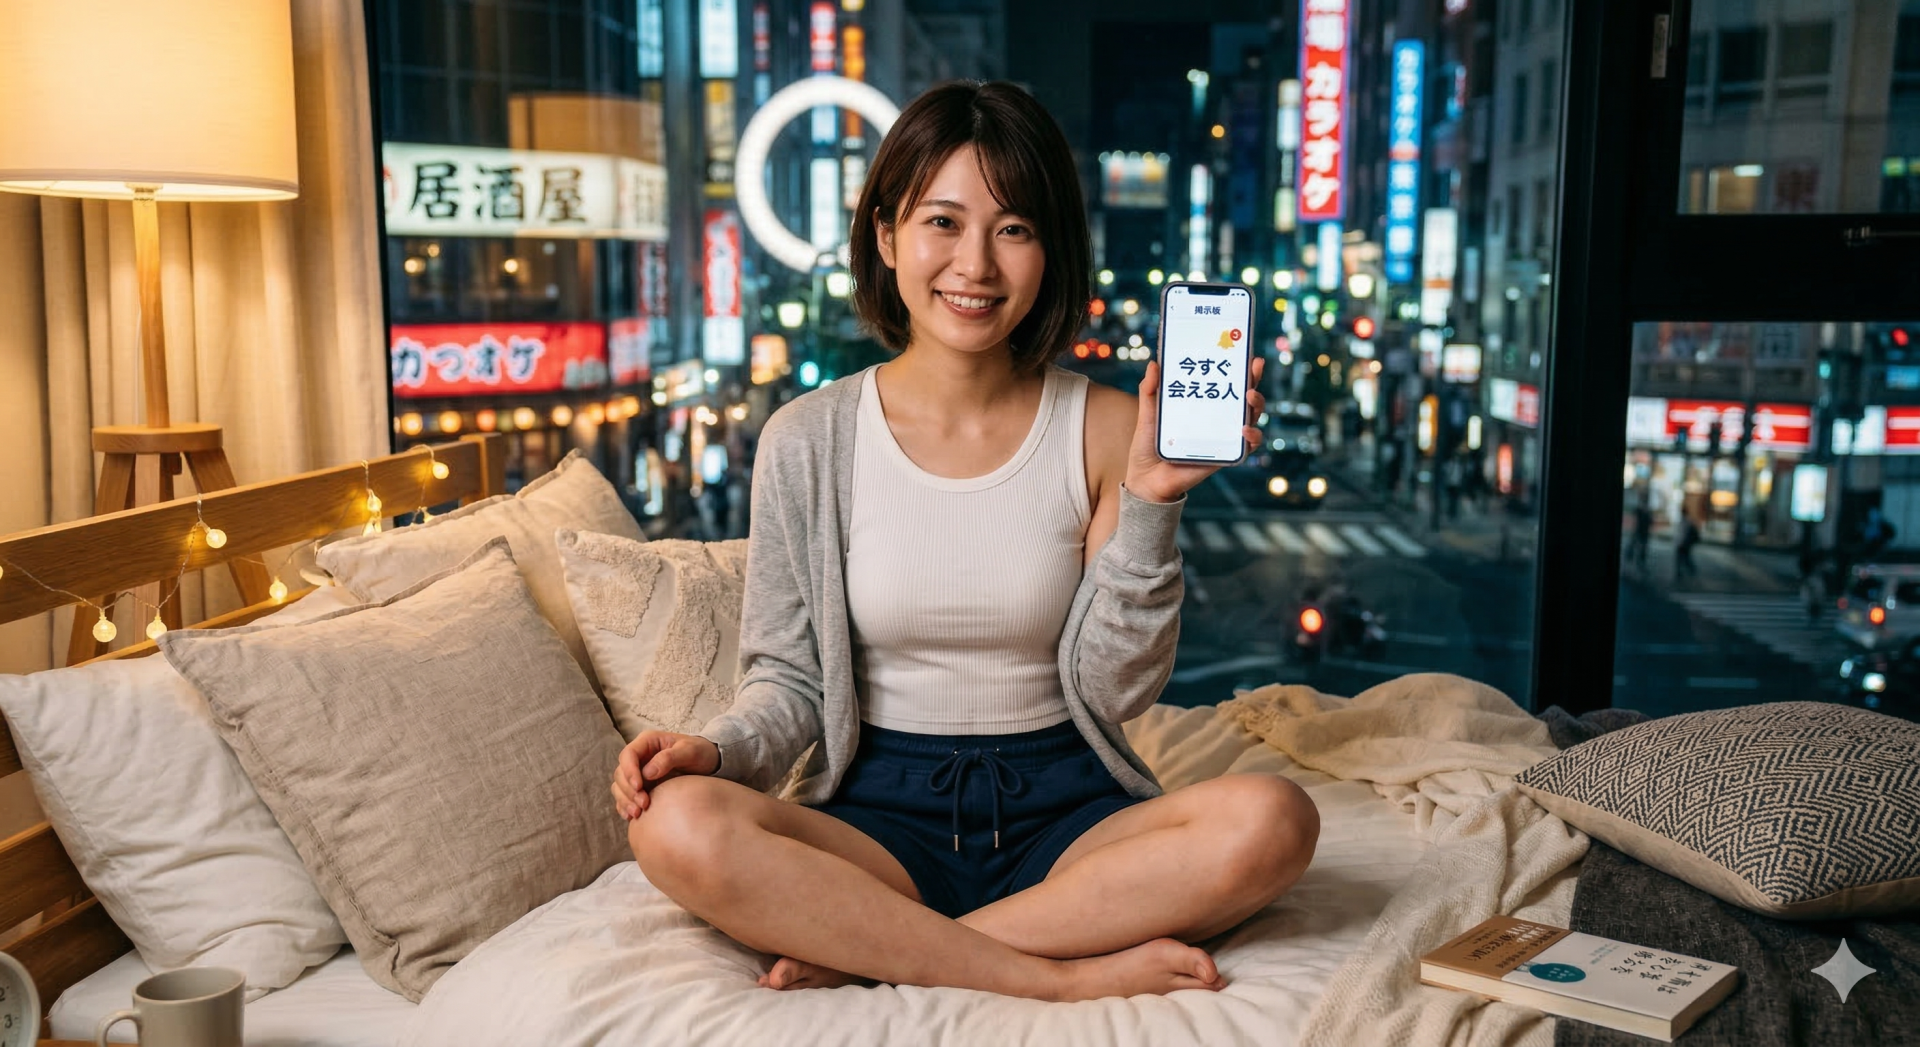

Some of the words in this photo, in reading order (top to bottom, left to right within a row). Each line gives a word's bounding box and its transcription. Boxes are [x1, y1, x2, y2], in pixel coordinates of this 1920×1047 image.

[1303, 61, 1341, 211] カラオケ
[408, 162, 586, 223] 居酒屋
[1179, 357, 1231, 376] 今すぐ
[1168, 380, 1239, 400] 会える人
[4, 1014, 13, 1029] 3
